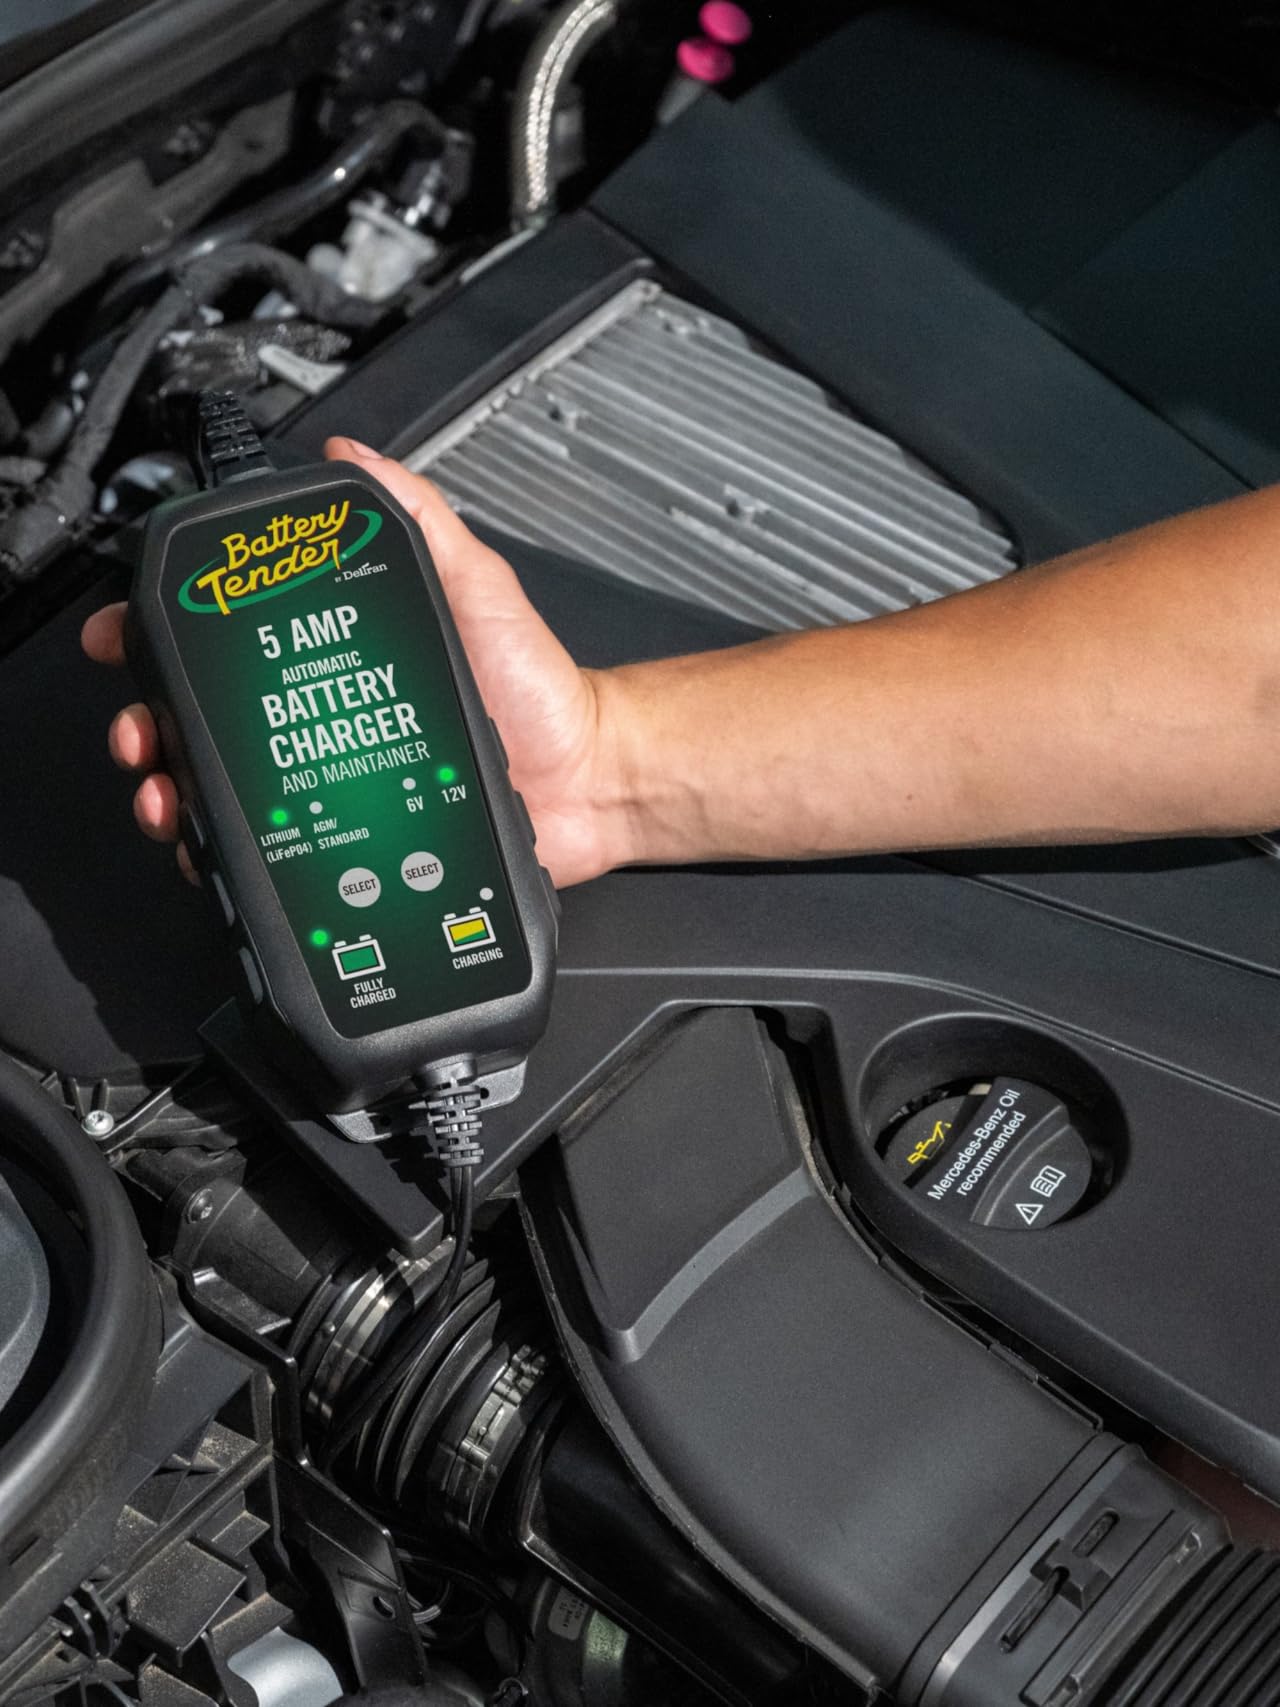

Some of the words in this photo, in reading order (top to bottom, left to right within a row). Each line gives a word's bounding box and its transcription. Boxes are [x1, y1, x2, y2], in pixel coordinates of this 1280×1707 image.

[221, 500, 349, 571] Battery
[197, 540, 340, 616] Tender
[257, 625, 281, 659] 5
[292, 605, 359, 652] AMP
[281, 650, 362, 685] AUTOMATIC
[261, 664, 399, 729] BATTERY
[269, 702, 422, 769] CHARGER
[281, 769, 318, 795] AND
[321, 742, 431, 785] MAINTAINER
[406, 796, 425, 813] 6V
[441, 785, 467, 804] 12V
[260, 827, 301, 847] LITHIUM
[313, 818, 338, 834] AGM/
[317, 827, 370, 851] STANDARD
[404, 862, 440, 881] SELECT
[342, 878, 377, 896] SELECT
[452, 947, 504, 970] CHARGING
[350, 987, 397, 1009] CHARGED
[353, 977, 385, 995] FULLY
[927, 1107, 1007, 1200] Mercedes-Benz
[999, 1088, 1021, 1109] Oil
[956, 1111, 1026, 1196] recommended
